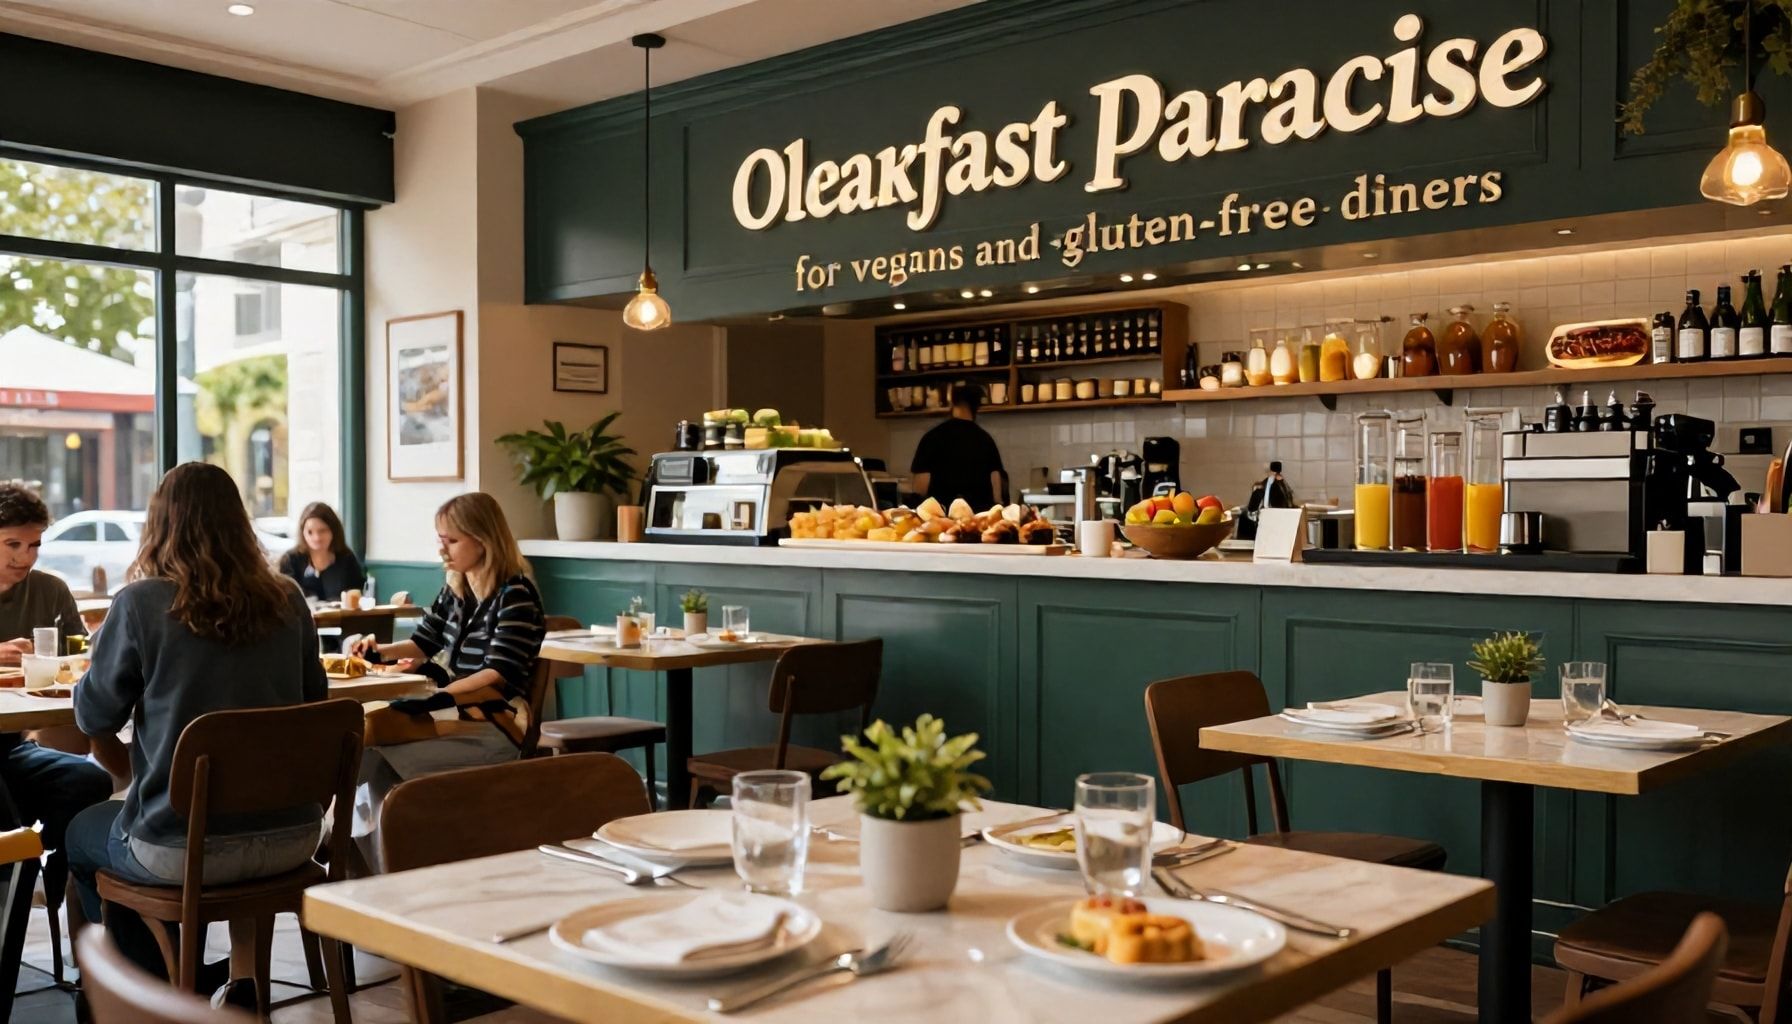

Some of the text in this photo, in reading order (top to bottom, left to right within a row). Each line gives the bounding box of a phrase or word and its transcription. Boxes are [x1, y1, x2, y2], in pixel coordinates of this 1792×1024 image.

[732, 13, 1545, 232] Oleakfast Paracise
[795, 255, 842, 292] for
[850, 246, 964, 287] vegans
[975, 222, 1040, 266] and
[1340, 170, 1502, 221] diners
